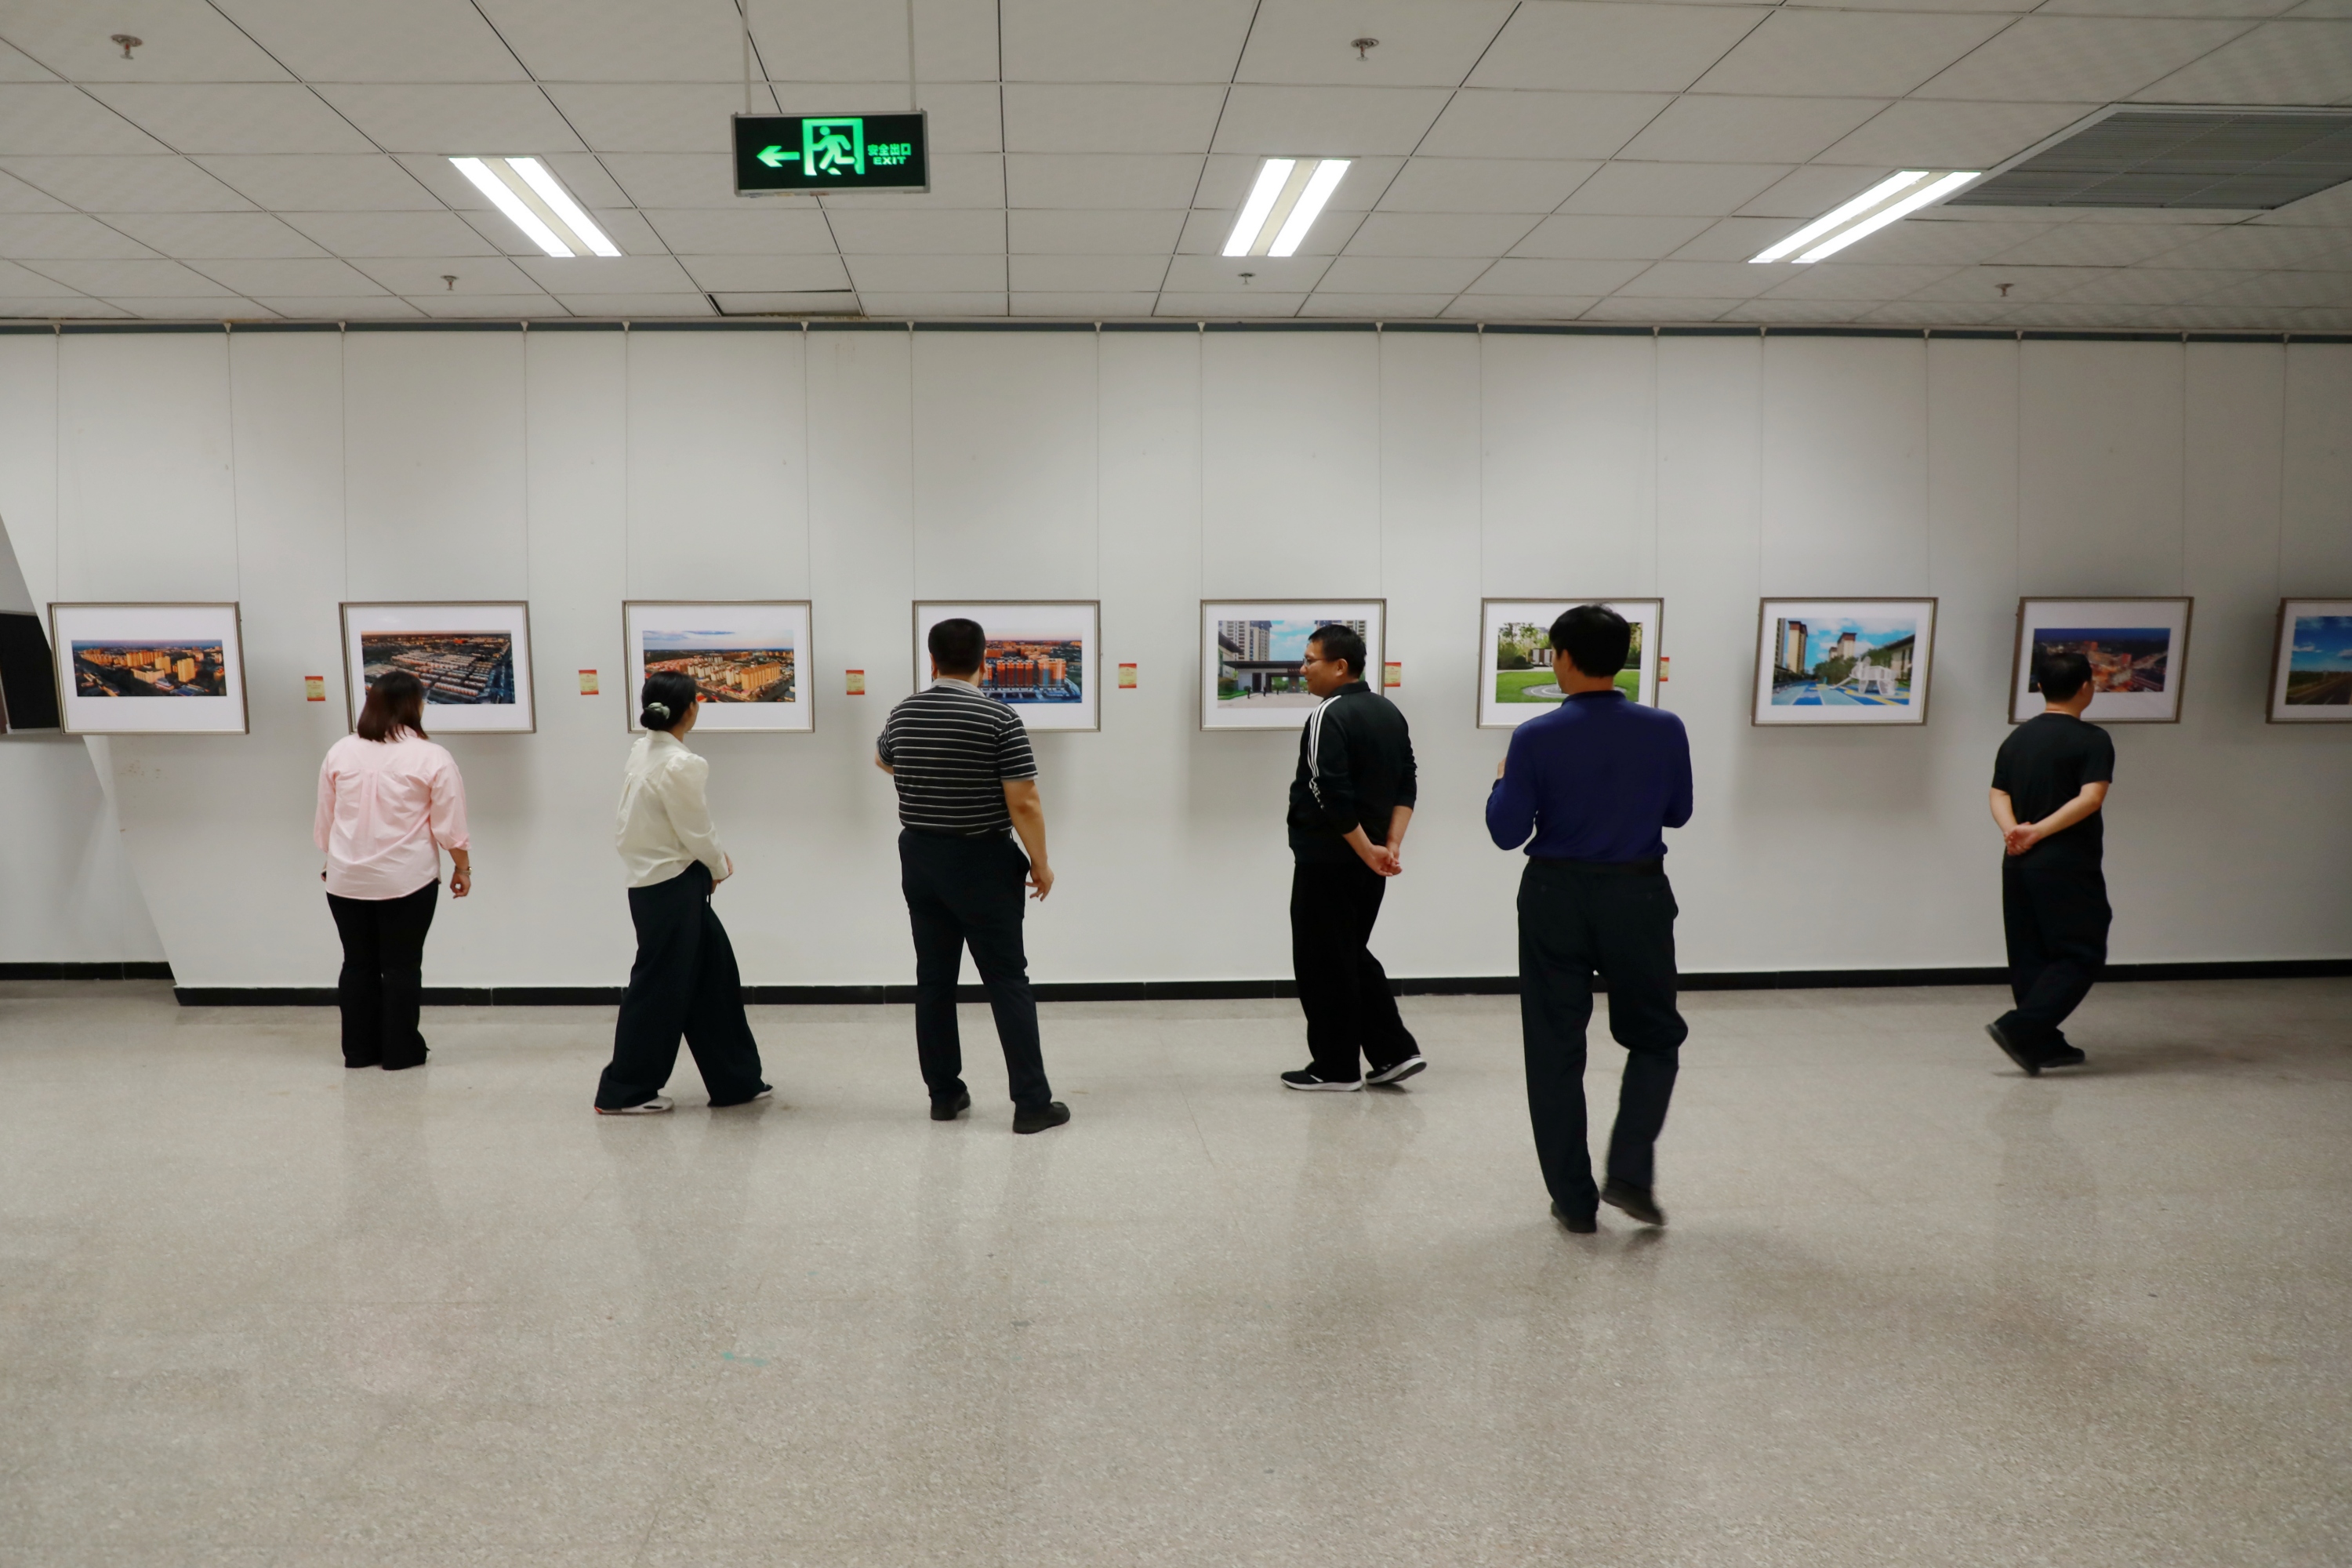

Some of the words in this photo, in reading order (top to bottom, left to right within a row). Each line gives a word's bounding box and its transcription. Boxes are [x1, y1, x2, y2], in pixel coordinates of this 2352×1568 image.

[867, 143, 911, 156] 安全出口
[873, 156, 906, 165] EXIT
